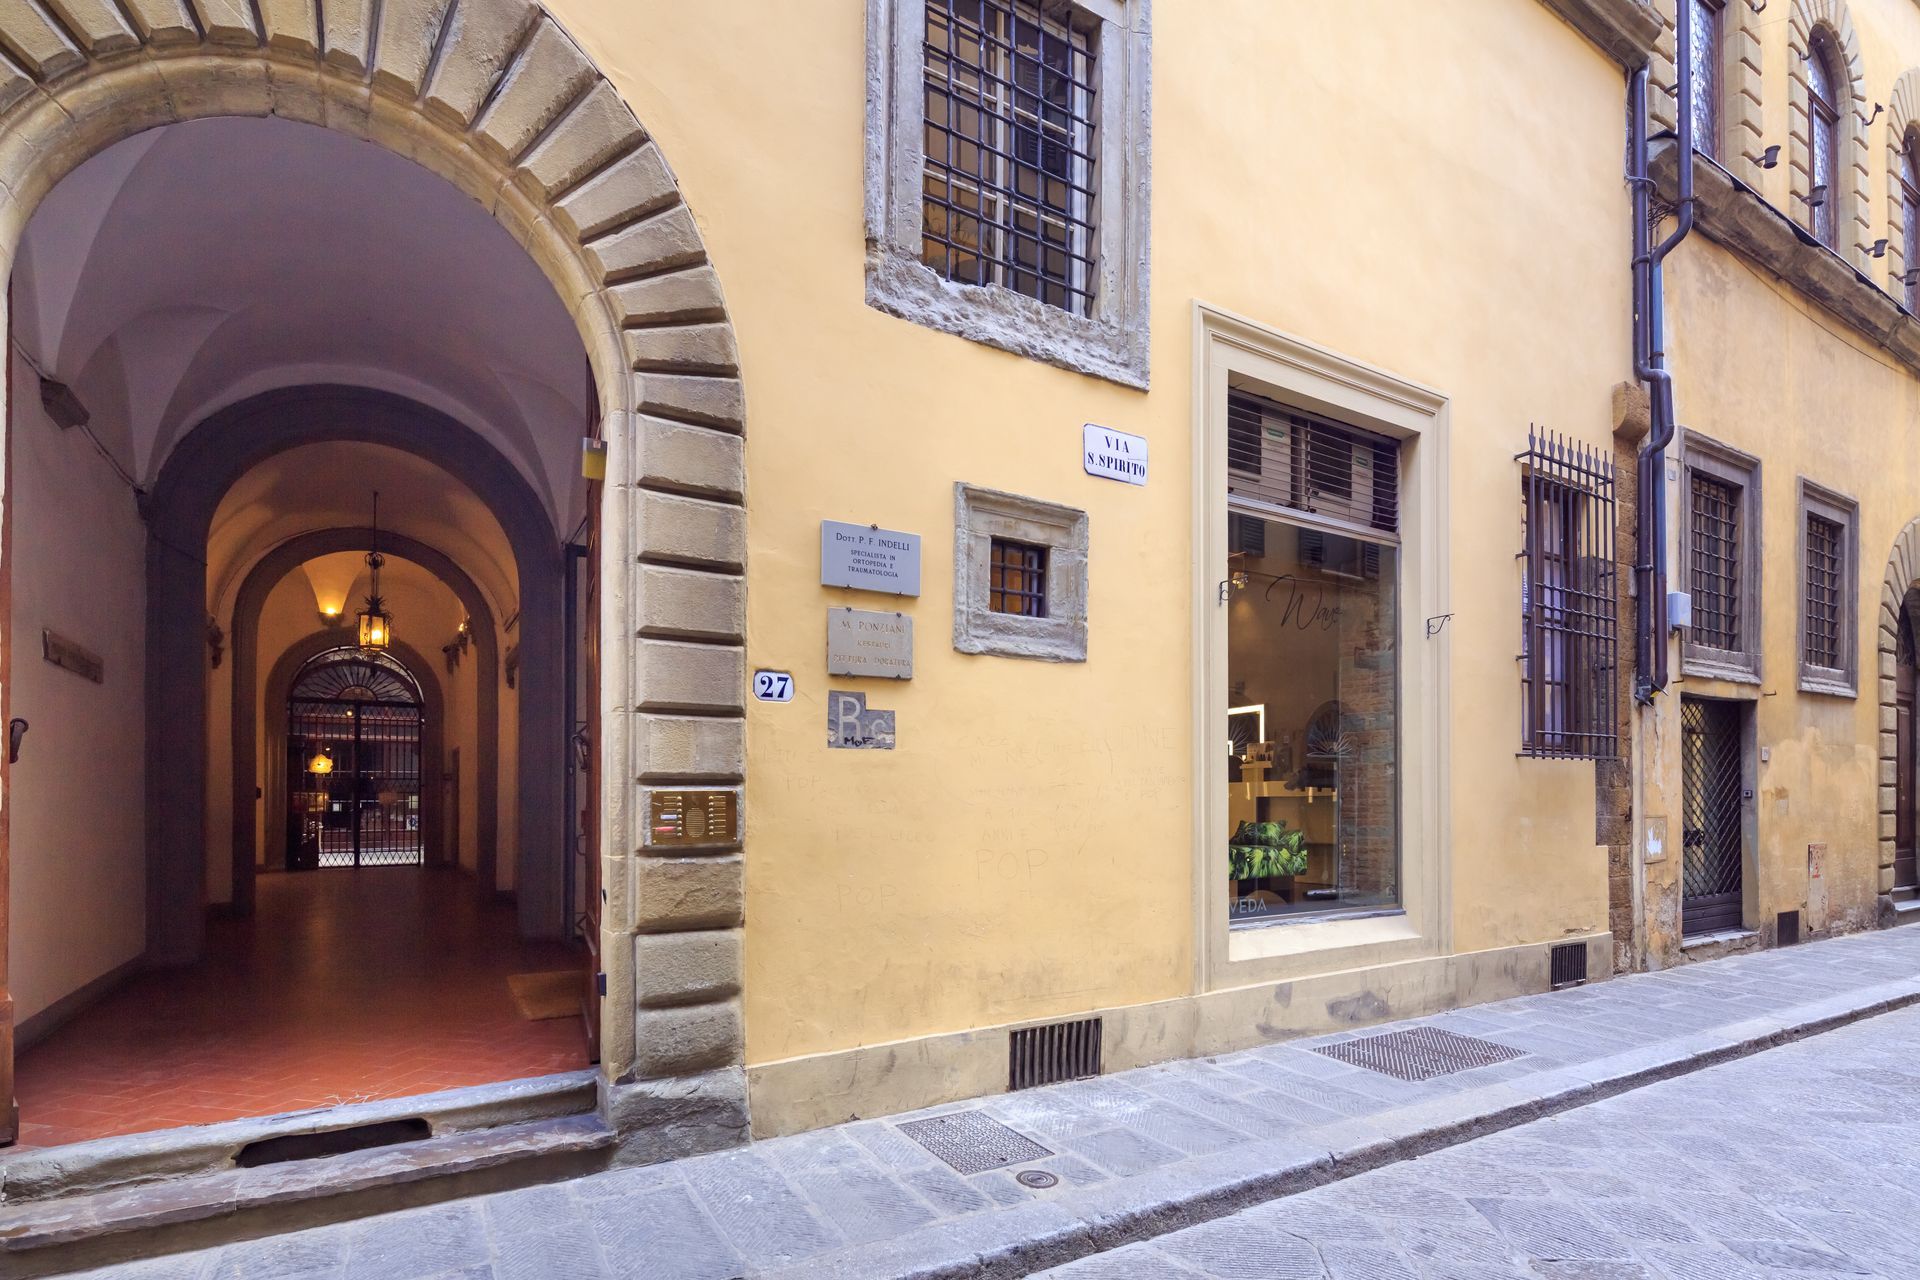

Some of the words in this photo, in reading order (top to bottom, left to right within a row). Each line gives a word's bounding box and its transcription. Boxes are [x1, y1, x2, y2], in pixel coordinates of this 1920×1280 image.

[1105, 436, 1129, 453] VIA
[1087, 451, 1145, 478] S.SPIRITO
[878, 539, 910, 551] INDELLI
[850, 549, 887, 560] SPECIALISTA
[852, 558, 887, 568] ORTOPEDIA
[848, 566, 899, 578] TRAUMATOLOGIA
[858, 620, 905, 634] PONZIANI
[760, 675, 790, 699] 27
